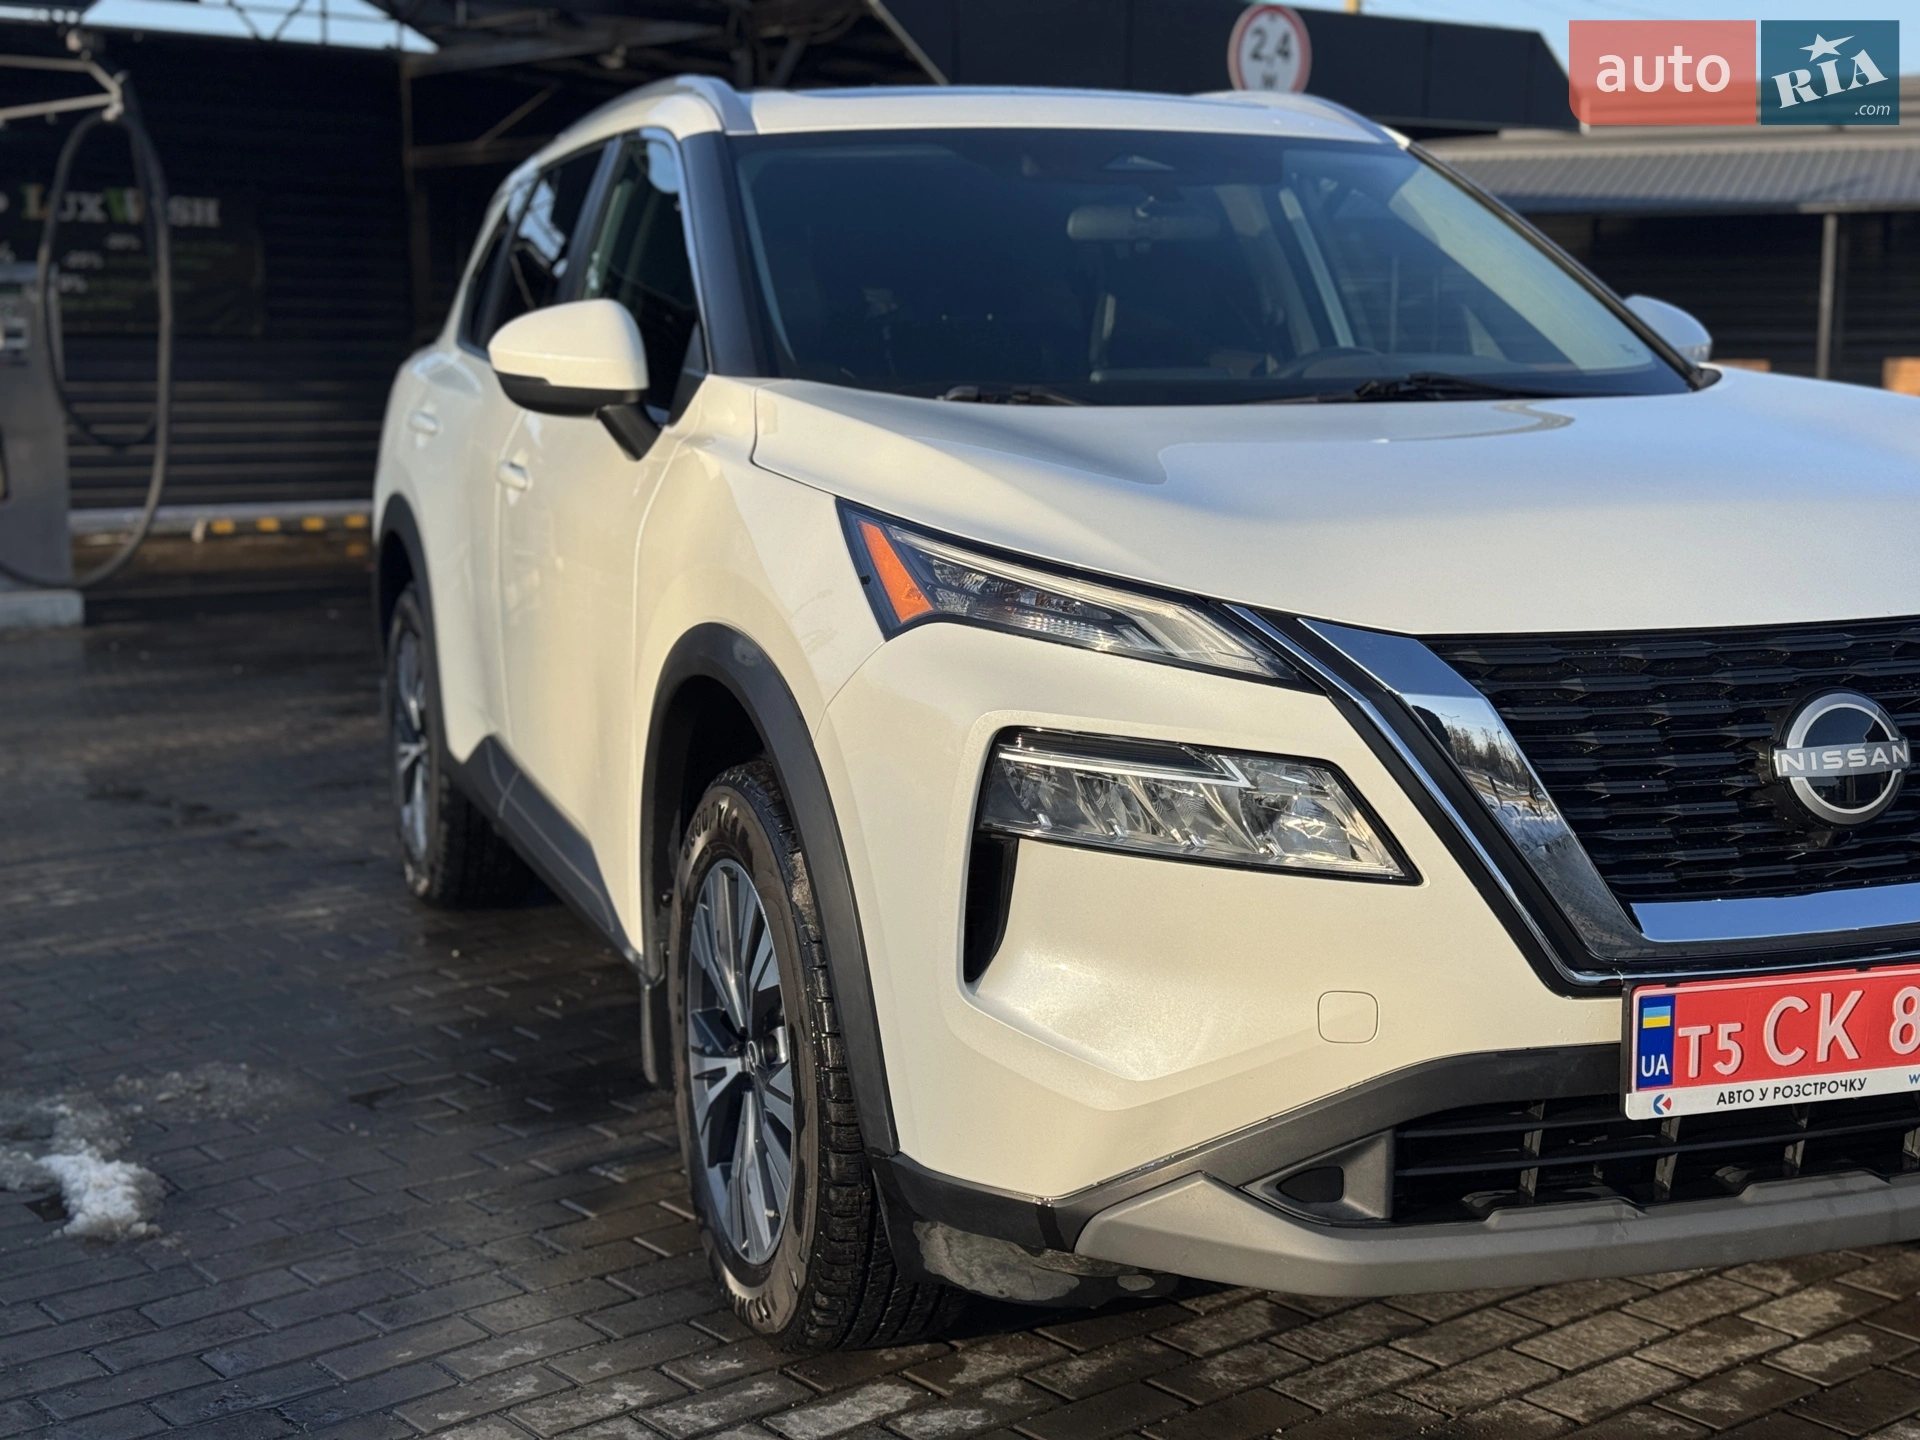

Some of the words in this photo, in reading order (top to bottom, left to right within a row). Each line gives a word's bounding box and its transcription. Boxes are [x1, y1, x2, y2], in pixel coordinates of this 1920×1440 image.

[1780, 744, 1909, 773] NISSAN
[1641, 1054, 1670, 1078] UA
[1716, 1088, 1755, 1106] АВТО
[1759, 1087, 1769, 1101] У
[1773, 1077, 1868, 1101] РОЗСТРОЧКУ
